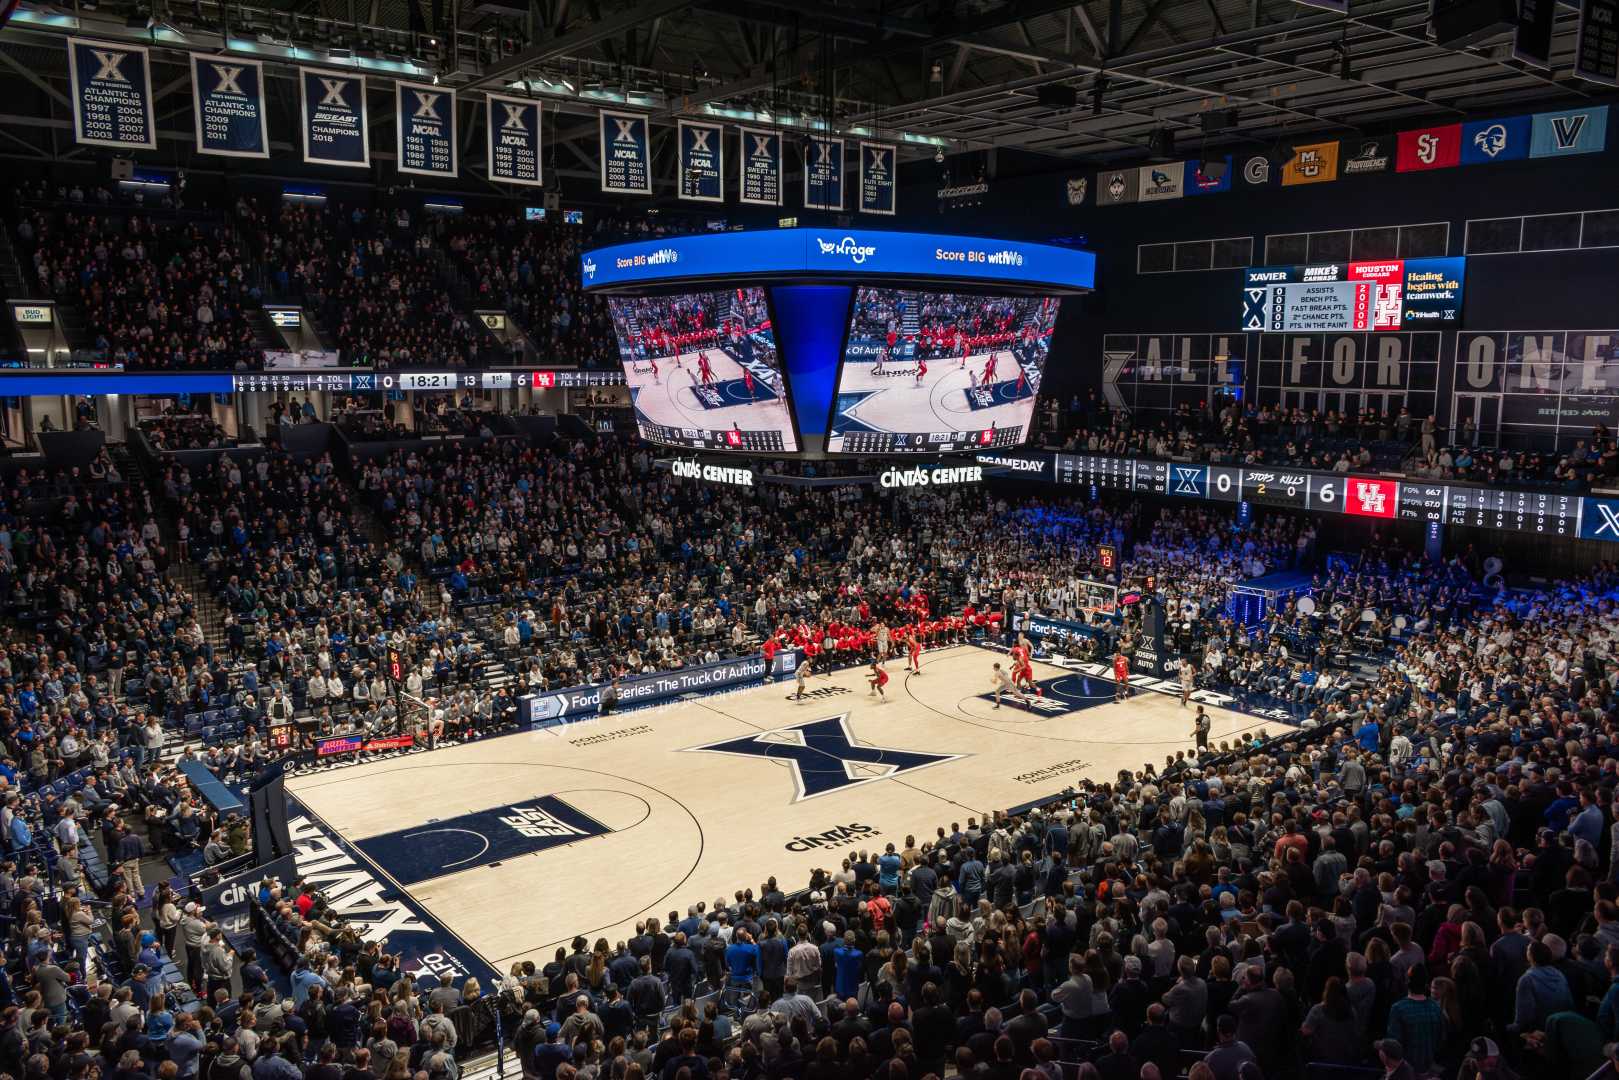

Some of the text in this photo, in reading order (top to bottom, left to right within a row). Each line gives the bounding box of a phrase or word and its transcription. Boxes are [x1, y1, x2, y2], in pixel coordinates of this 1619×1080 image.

[84, 88, 128, 98] ATLANTIC
[84, 95, 142, 106] CHAMPIONS
[205, 100, 244, 110] ATLANTIC
[86, 104, 142, 115] 1997 2004
[205, 107, 256, 117] CHAMPIONS
[86, 113, 143, 124] 1998 2006
[206, 115, 228, 123] 2009
[313, 112, 358, 123] BIG EAST
[86, 122, 143, 132] 2002 2007
[206, 124, 227, 132] 2010
[312, 126, 360, 136] CHAMPIONS
[412, 124, 441, 137] NCAA
[1551, 114, 1589, 149] V
[87, 130, 144, 142] 2003 2008
[207, 132, 227, 140] 2011
[312, 134, 333, 142] 2018
[501, 136, 527, 147] NCAA
[406, 144, 424, 152] 1983
[431, 154, 448, 162] 1990
[614, 150, 638, 159] NCAA
[1244, 156, 1269, 184] G
[836, 237, 876, 264] Kroger
[936, 249, 986, 262] Score BIG
[616, 255, 646, 268] Score BIG
[1304, 265, 1338, 276] MIKE'S
[1356, 265, 1398, 274] HOUSTON
[1249, 272, 1287, 282] XAVIER
[1408, 272, 1443, 282] Healing
[1408, 280, 1458, 292] begins with
[1407, 290, 1454, 300] teamwork.
[1144, 336, 1610, 390] ALL FOR ONE
[384, 376, 393, 388] 0
[410, 376, 448, 388] 18:21
[464, 376, 476, 386] 13
[492, 376, 502, 385] 1st
[518, 374, 526, 386] 6
[716, 432, 723, 442] 6
[916, 435, 922, 445] 0
[970, 433, 976, 442] 6
[703, 464, 752, 486] CENTER
[932, 466, 982, 484] CENTER
[1217, 474, 1231, 492] 0
[1246, 472, 1275, 482] STOPS
[1280, 474, 1304, 485] KILLS
[1320, 484, 1335, 503] 6
[1257, 483, 1296, 496] 2 0
[1404, 487, 1442, 496] FG% 66.7
[1454, 494, 1467, 502] PTS
[1425, 500, 1440, 508] 67.0
[1402, 510, 1440, 520] FT% 0.0
[1030, 621, 1050, 634] Ford
[1136, 650, 1158, 661] JOSEPH
[1138, 660, 1154, 669] AUTO
[572, 662, 776, 708] Ford The Truck Of Authoriy
[278, 736, 286, 744] 13
[824, 830, 882, 850] CENTER
